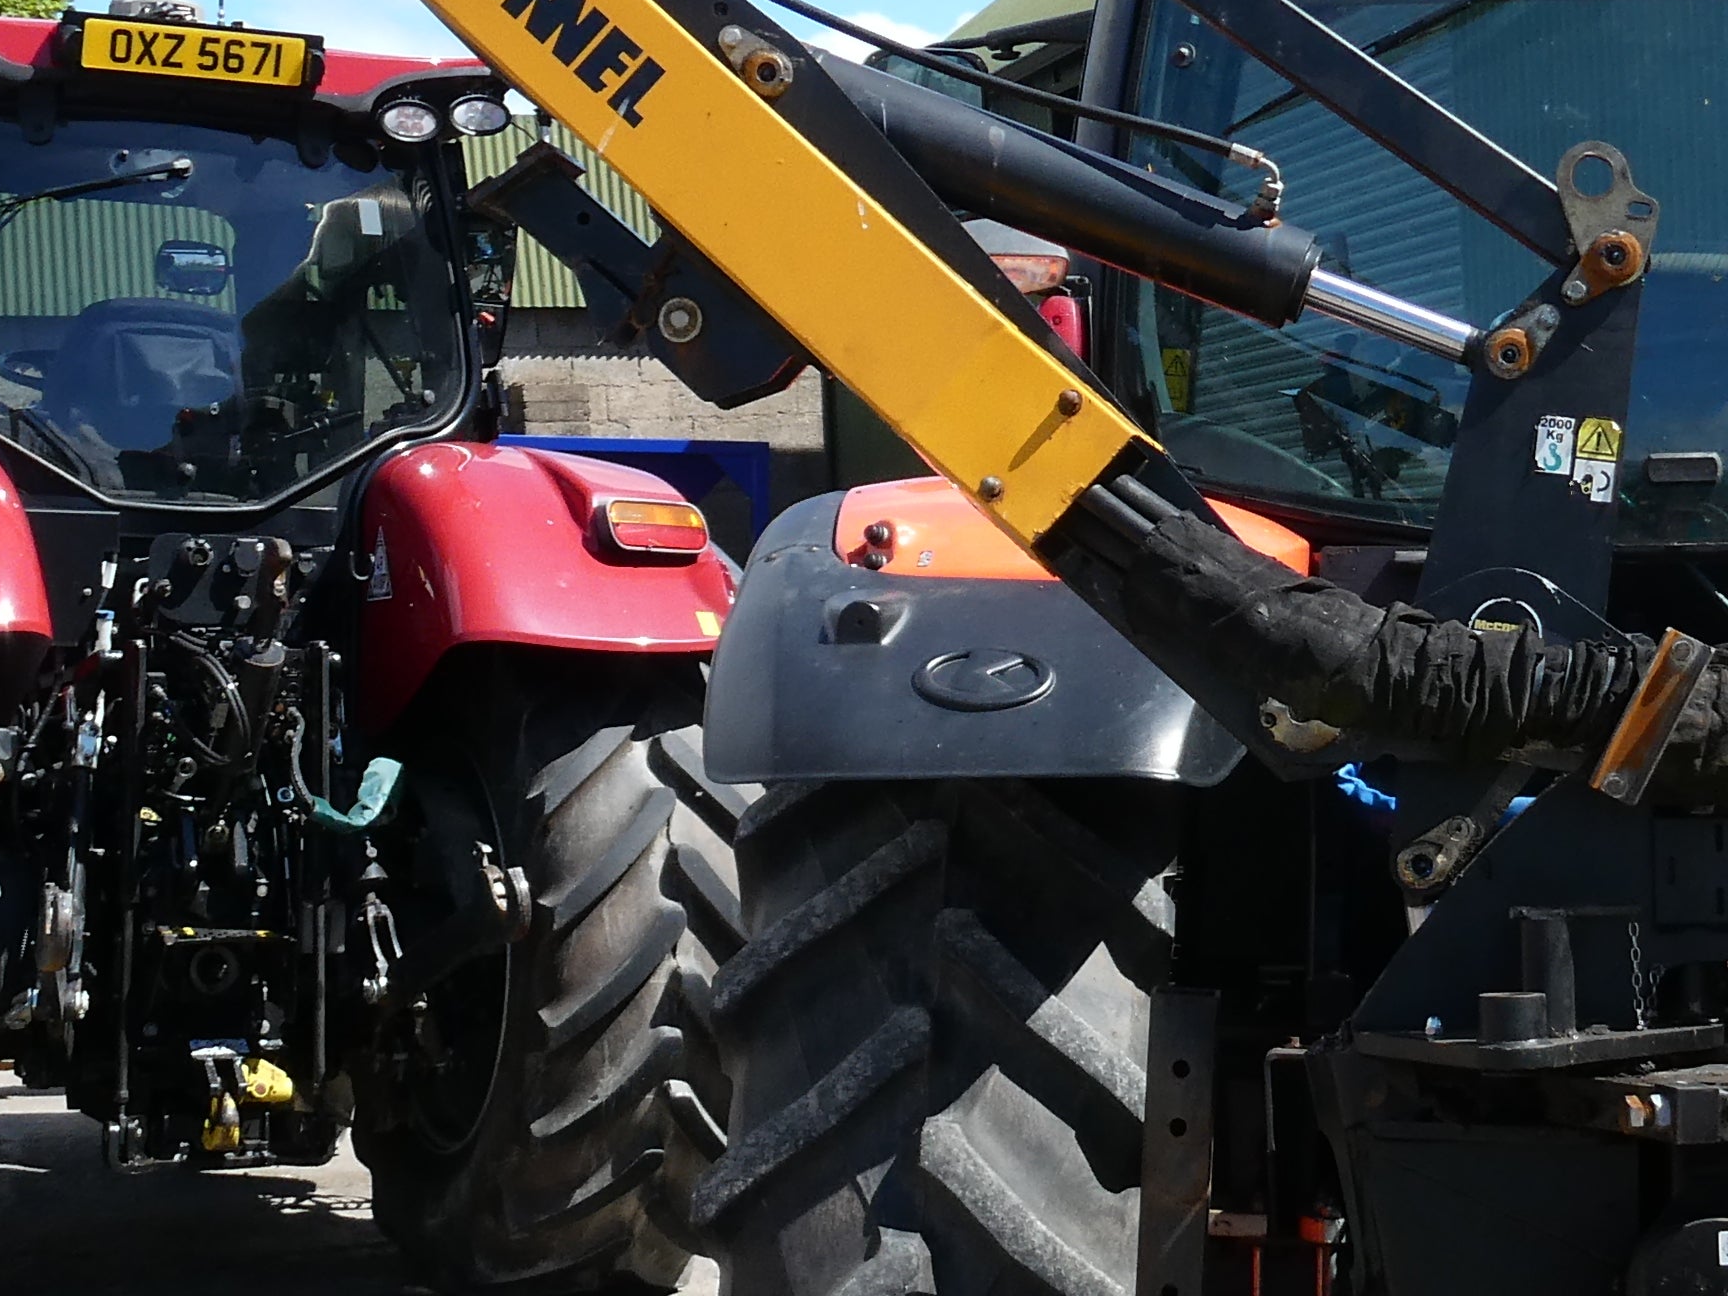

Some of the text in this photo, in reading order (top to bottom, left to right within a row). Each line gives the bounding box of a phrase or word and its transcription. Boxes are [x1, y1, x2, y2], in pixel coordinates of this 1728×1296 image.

[109, 29, 283, 77] OXZ 5671
[1540, 417, 1573, 431] 2000
[1546, 429, 1564, 444] Kg
